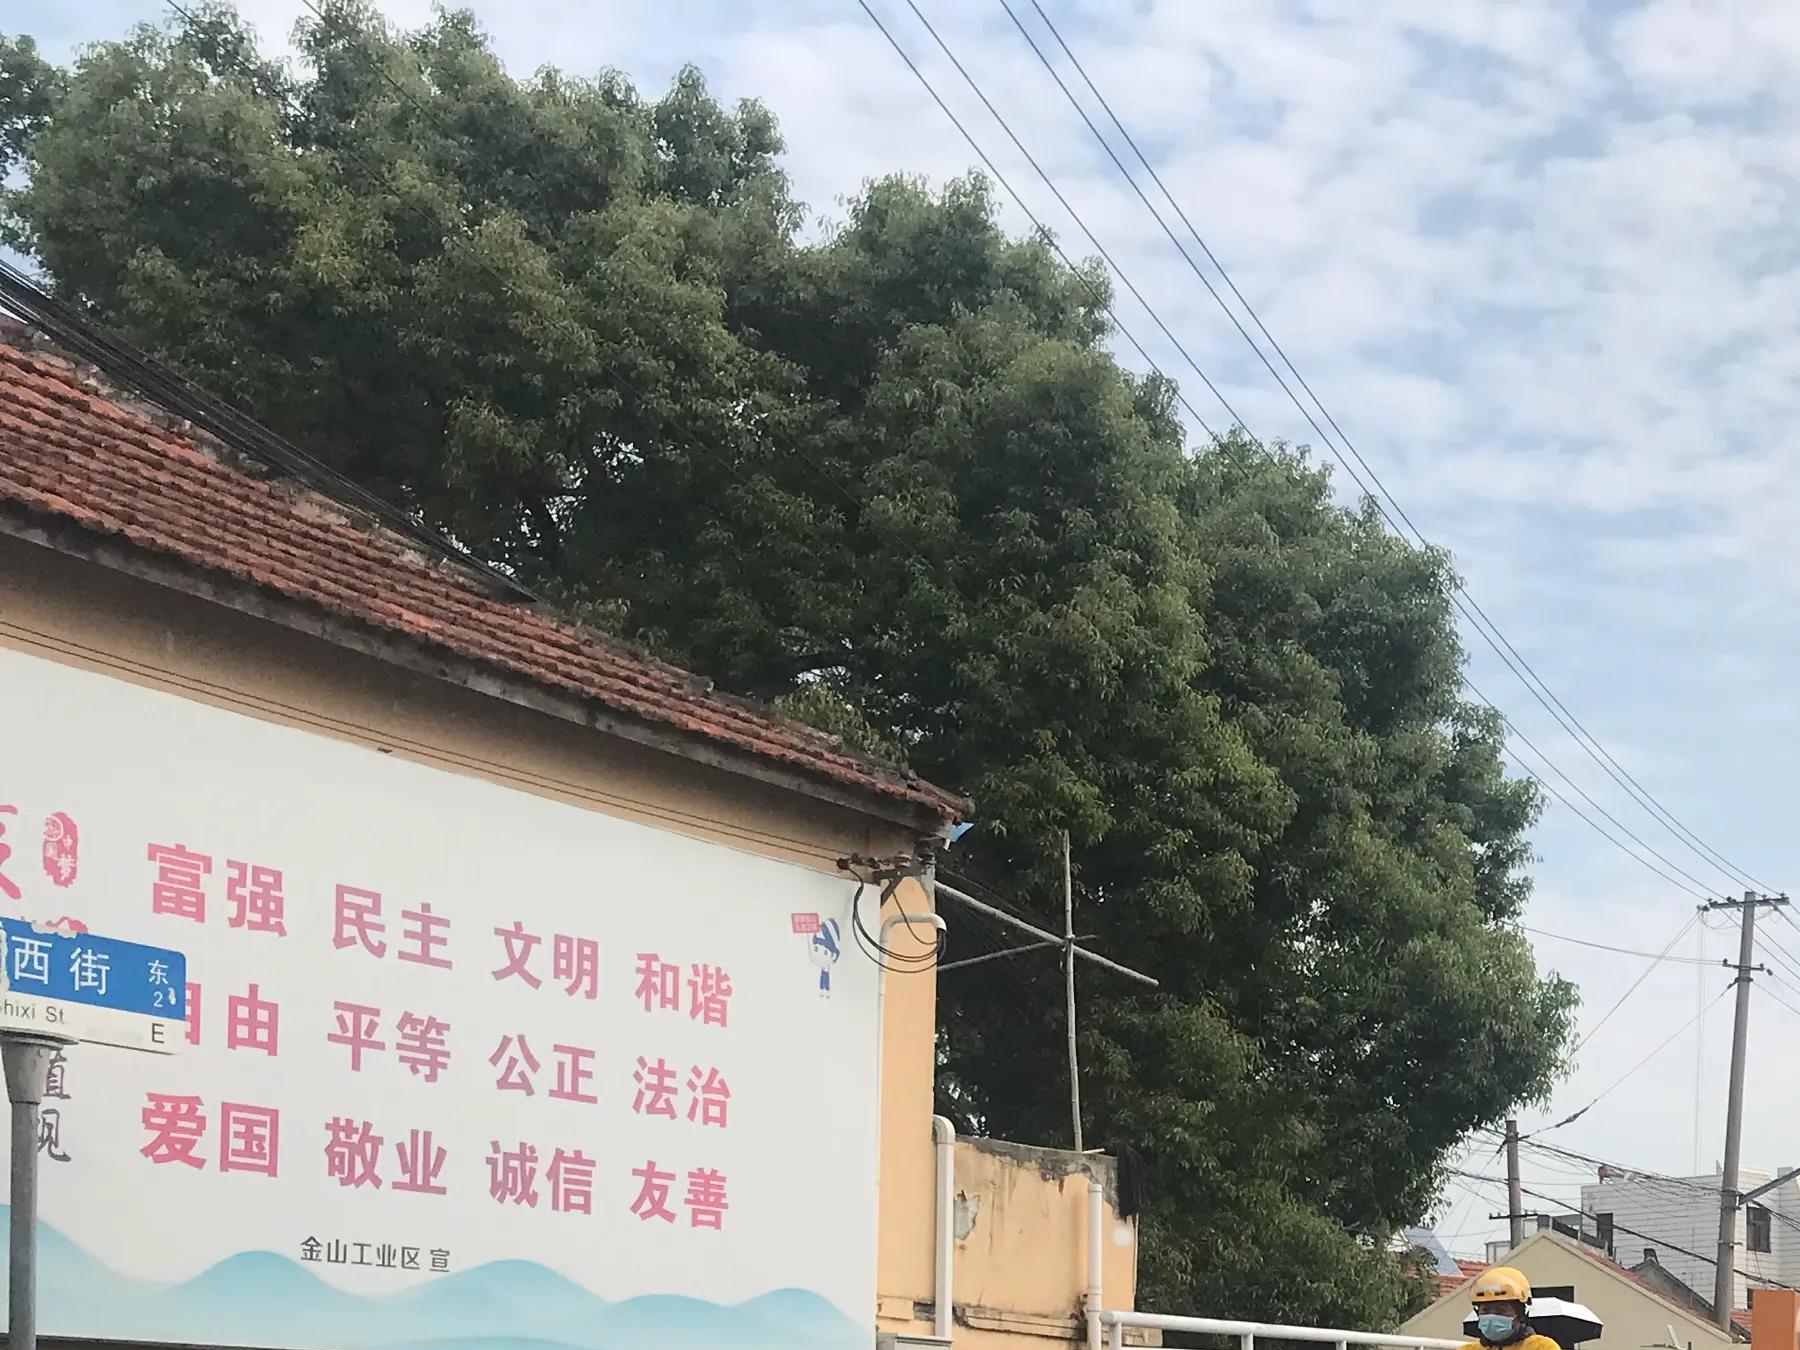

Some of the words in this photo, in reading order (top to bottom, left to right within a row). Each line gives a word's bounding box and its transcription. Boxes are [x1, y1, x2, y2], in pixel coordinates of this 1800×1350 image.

[147, 842, 287, 938] 富强
[332, 883, 453, 970] 民主
[491, 921, 599, 1000] 文明
[634, 953, 733, 1027] 和谐
[10, 935, 110, 995] 西街
[147, 959, 170, 986] 东
[0, 999, 35, 1020] hixi
[45, 1006, 65, 1025] St
[151, 1023, 165, 1045] E
[328, 1000, 451, 1083] 平等
[488, 1034, 598, 1104] 公正
[632, 1055, 731, 1128] 法治
[139, 1092, 280, 1177] 爱国
[324, 1117, 448, 1195] 敬业
[486, 1140, 597, 1215] 诚信
[630, 1160, 729, 1230] 友善
[301, 1236, 420, 1270] 金山工业区
